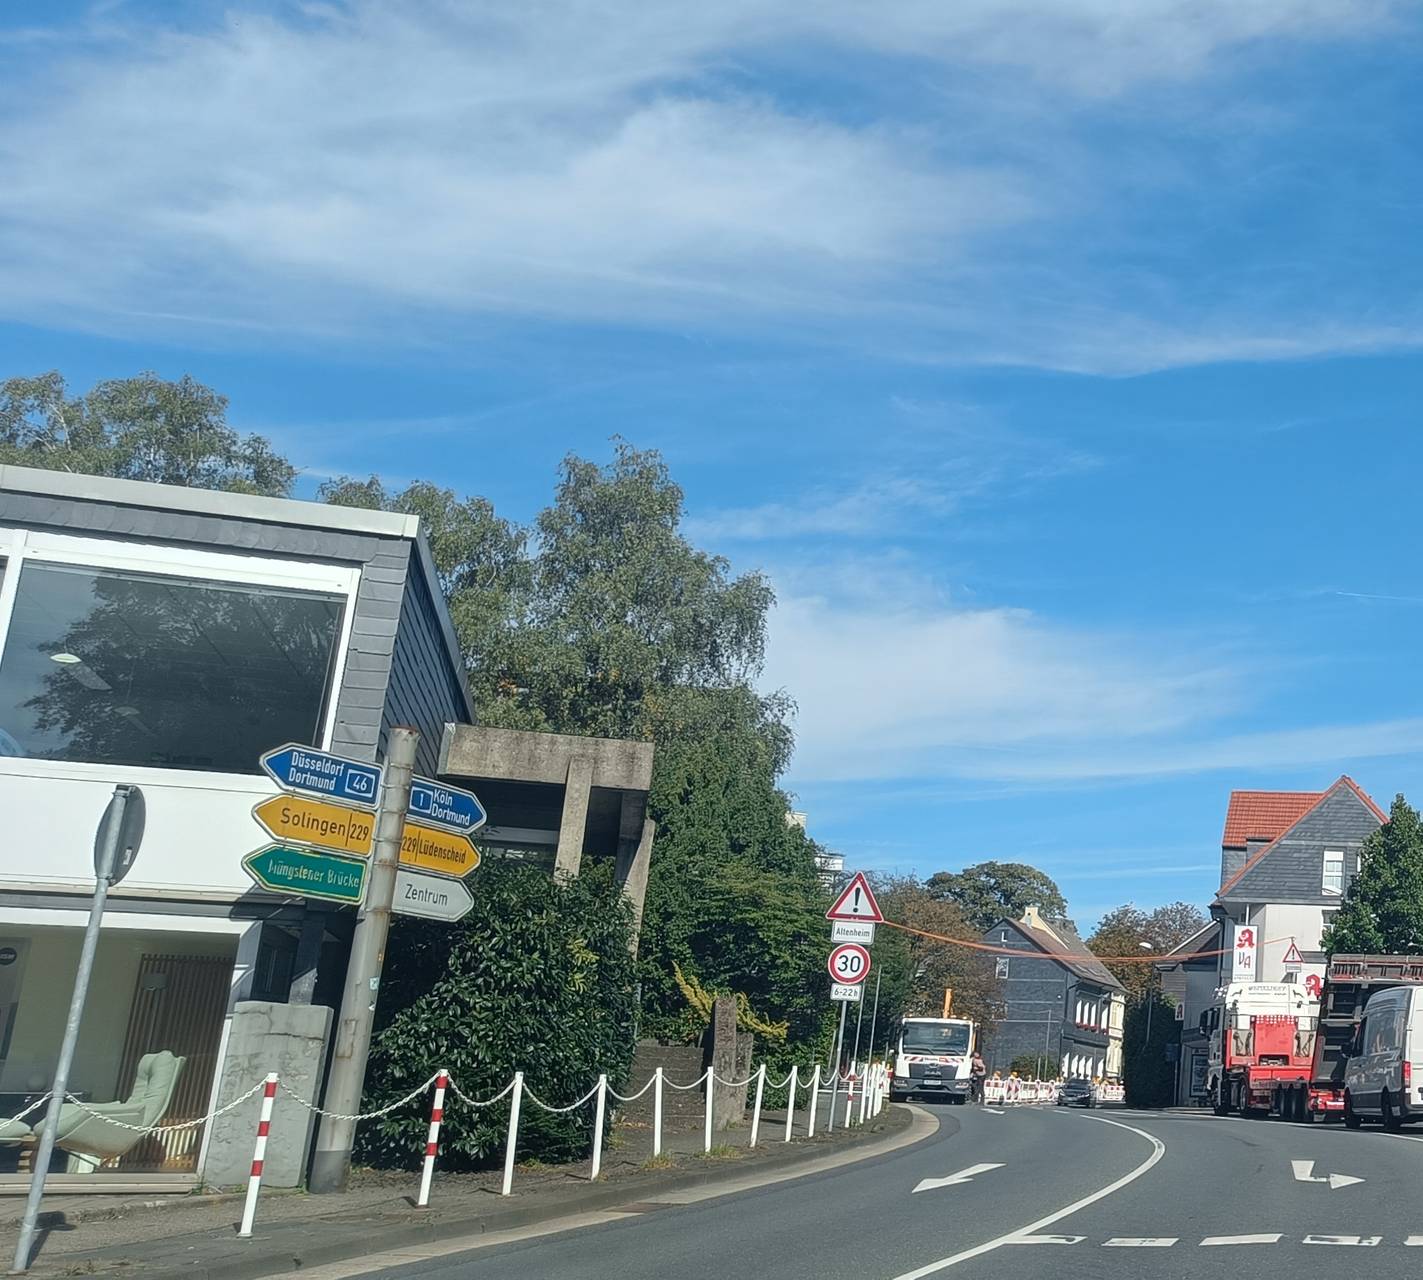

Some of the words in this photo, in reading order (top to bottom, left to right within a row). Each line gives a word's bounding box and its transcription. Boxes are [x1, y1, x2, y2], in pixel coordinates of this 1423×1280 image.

[291, 751, 345, 777] Düsseldorf
[288, 767, 337, 791] Dortmund
[352, 775, 367, 791] 46
[420, 793, 424, 807] 1
[433, 788, 453, 807] Köln
[280, 807, 346, 837] Solingen
[349, 823, 369, 841] 229
[431, 803, 471, 826] Dortmund
[401, 835, 417, 854] 229
[418, 838, 467, 864] Lüdenscheid
[405, 883, 448, 906] Zentrum
[835, 927, 870, 937] Altenheim
[837, 954, 861, 973] 30
